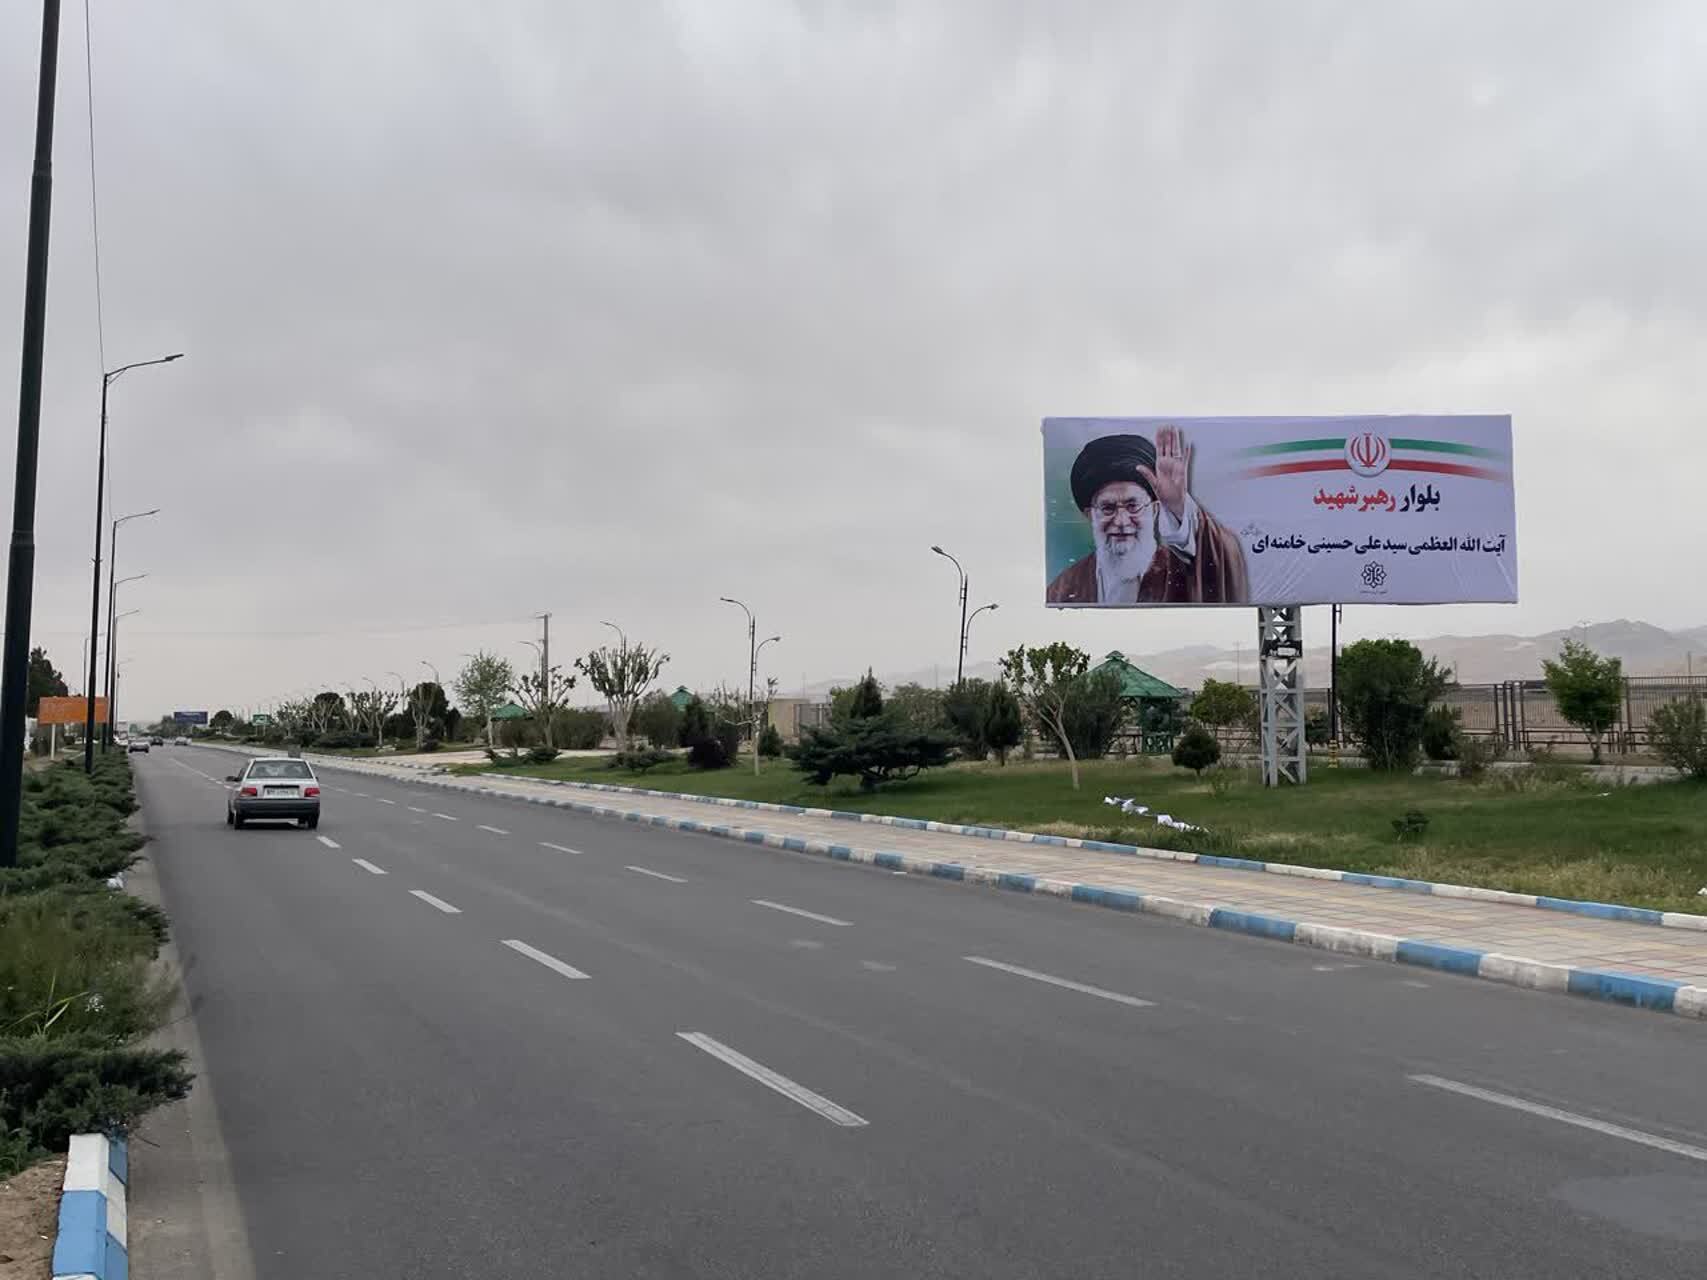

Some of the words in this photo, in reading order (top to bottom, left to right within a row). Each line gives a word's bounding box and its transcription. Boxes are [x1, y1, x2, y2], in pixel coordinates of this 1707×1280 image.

[1313, 485, 1359, 510] شهید
[1358, 489, 1396, 512] رهبر
[1399, 484, 1441, 512] بلوار
[1307, 537, 1353, 554] حسینی
[1354, 536, 1381, 554] علی
[1382, 538, 1408, 554] سید
[1408, 536, 1457, 555] العظمی
[1459, 534, 1481, 552] الله
[1482, 534, 1507, 556] آیت
